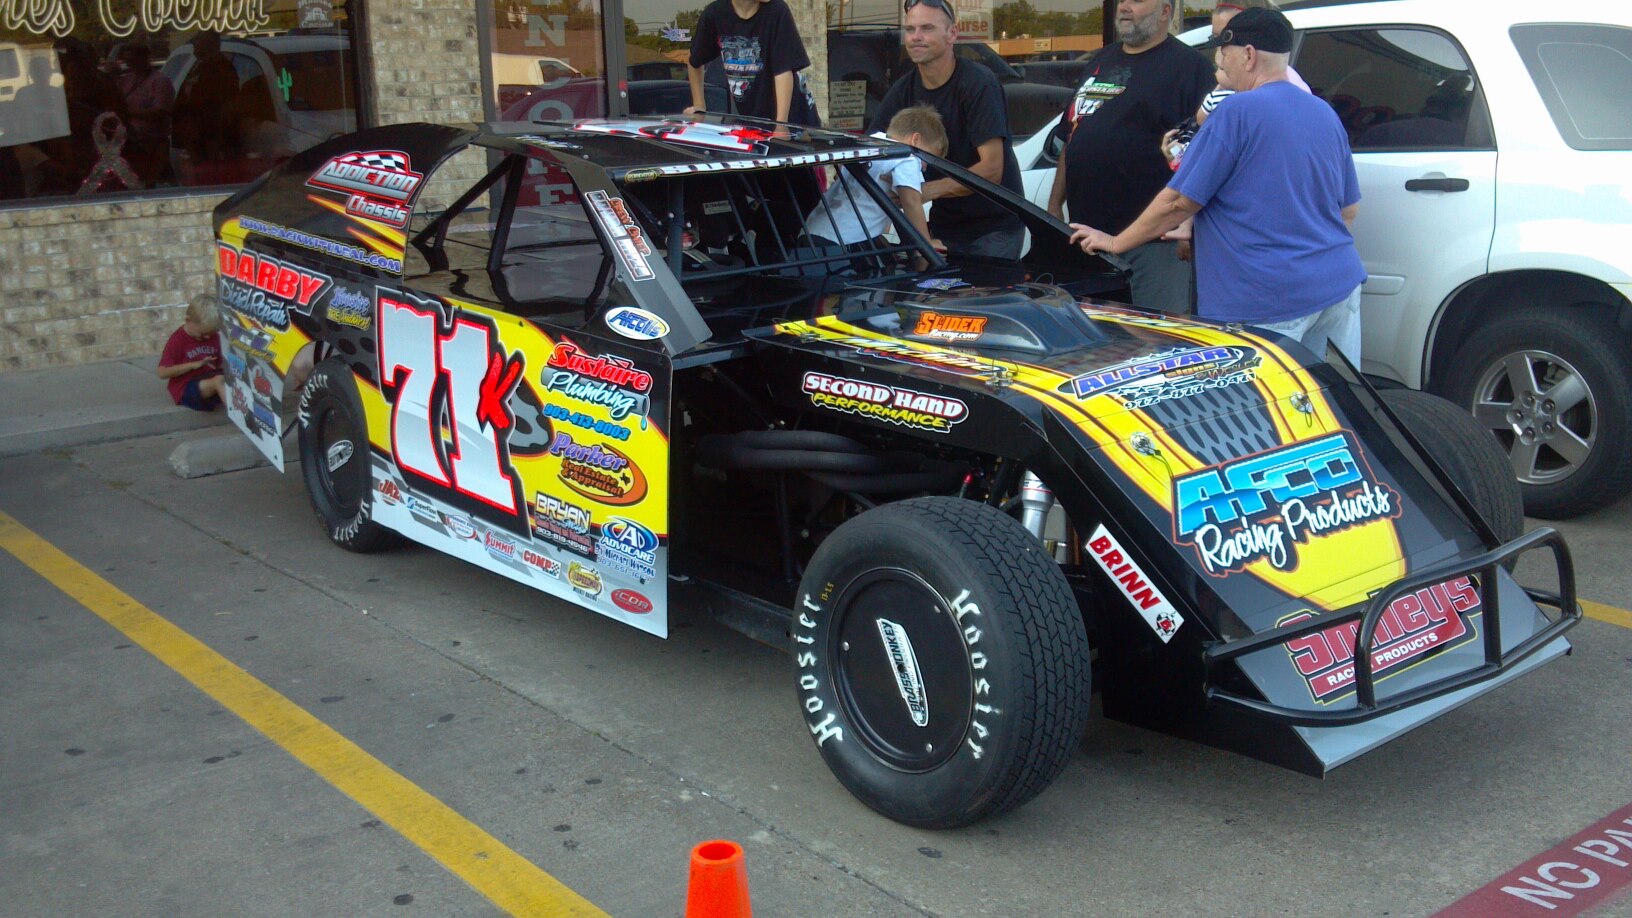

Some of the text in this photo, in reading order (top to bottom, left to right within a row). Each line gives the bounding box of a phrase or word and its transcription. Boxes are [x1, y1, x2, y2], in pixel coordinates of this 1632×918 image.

[313, 161, 419, 199] ADDICTION
[347, 195, 408, 223] Chassis
[219, 246, 326, 306] DARBY
[251, 291, 287, 326] Repair
[916, 311, 985, 333] SLIDER
[929, 328, 979, 341] Racing.com
[548, 344, 653, 391] Sustaire
[1078, 347, 1233, 394] ALLSTAR
[549, 371, 635, 419] Plumbing
[804, 375, 963, 418] SECOND HAND
[813, 392, 949, 428] PERFORMANCE
[543, 404, 631, 441] 903-413-8003
[550, 430, 627, 471] Parker
[379, 479, 400, 501] JAZ
[561, 459, 619, 485] Real Estate
[571, 471, 625, 498] Appraisal
[1179, 434, 1362, 536] AFCO
[536, 493, 592, 532] BRYAN
[1195, 481, 1391, 572] Racing Products
[523, 549, 553, 570] COMP
[600, 536, 656, 564] ADVOCARE
[1089, 534, 1161, 611] BRINN
[1375, 632, 1439, 665] PRODUCTS
[797, 593, 843, 748] Hoosier
[951, 588, 1003, 760] Hoosier
[899, 671, 921, 712] BRASS
[1500, 861, 1601, 910] NO
